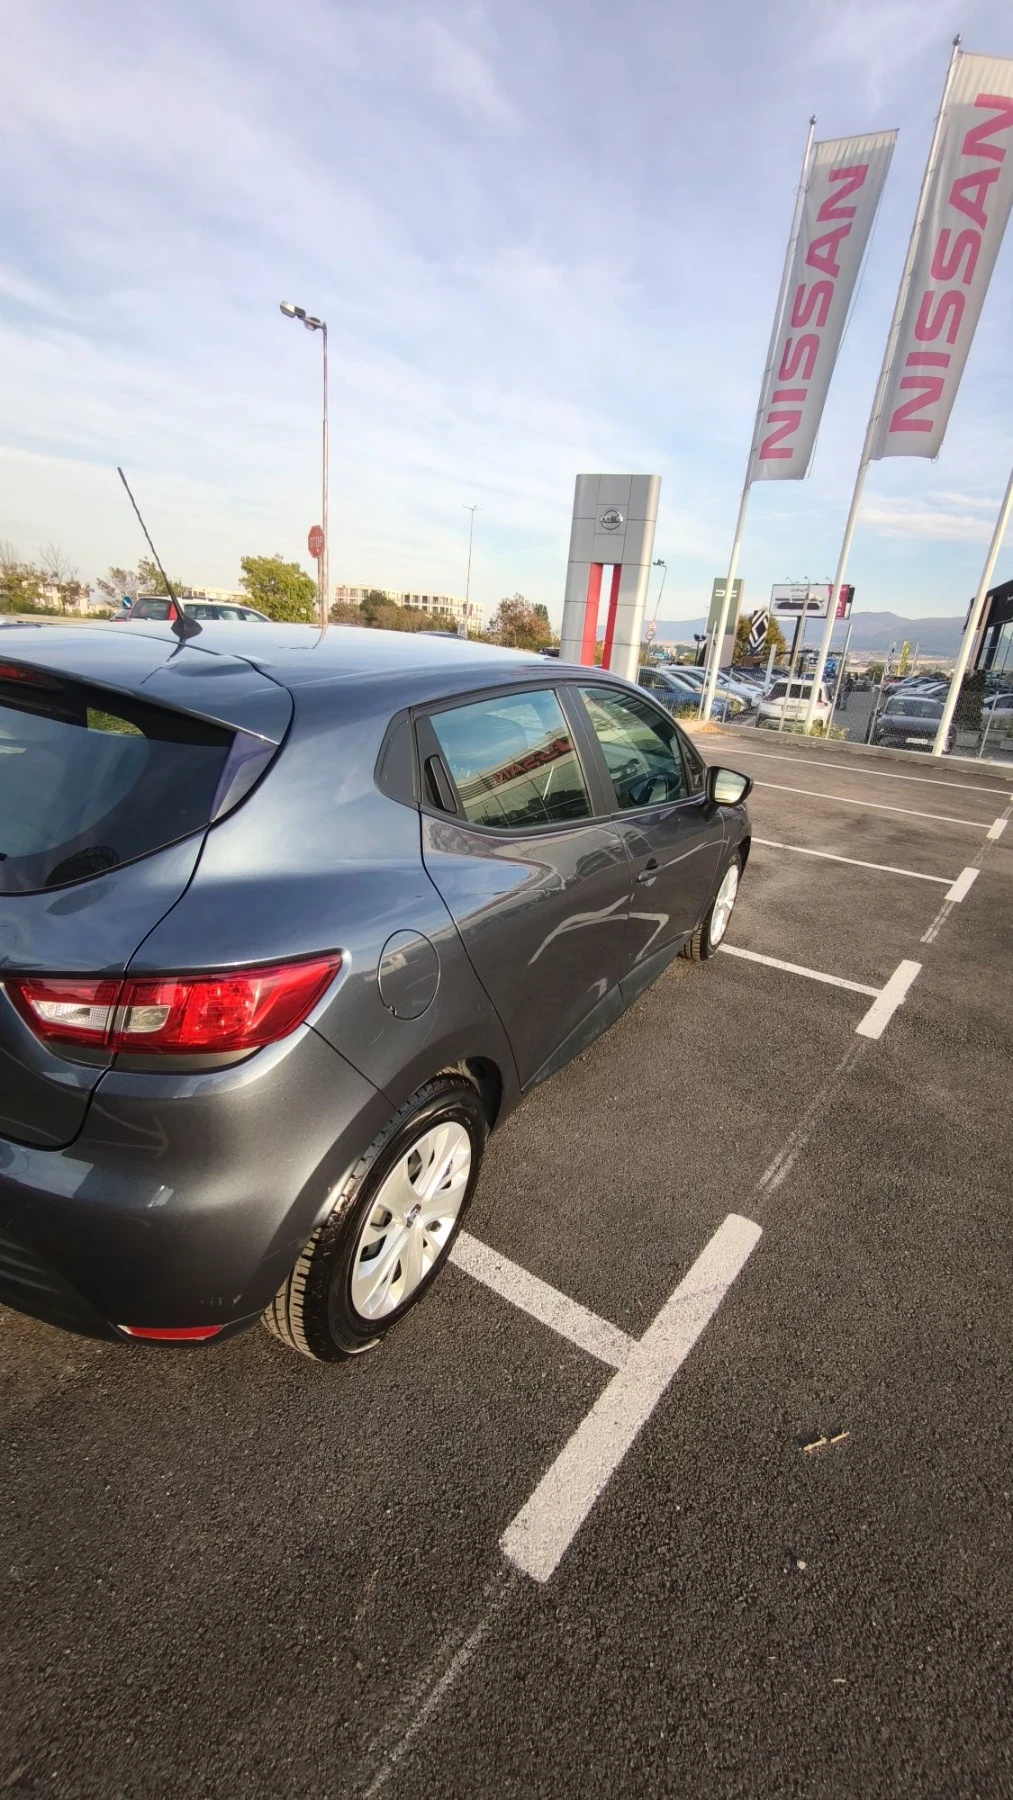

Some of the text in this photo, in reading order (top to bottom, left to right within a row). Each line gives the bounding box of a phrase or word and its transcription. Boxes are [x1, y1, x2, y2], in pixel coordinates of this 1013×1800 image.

[758, 164, 869, 461] NISSAN
[889, 93, 1013, 433] NISSAN
[309, 535, 324, 549] STOP
